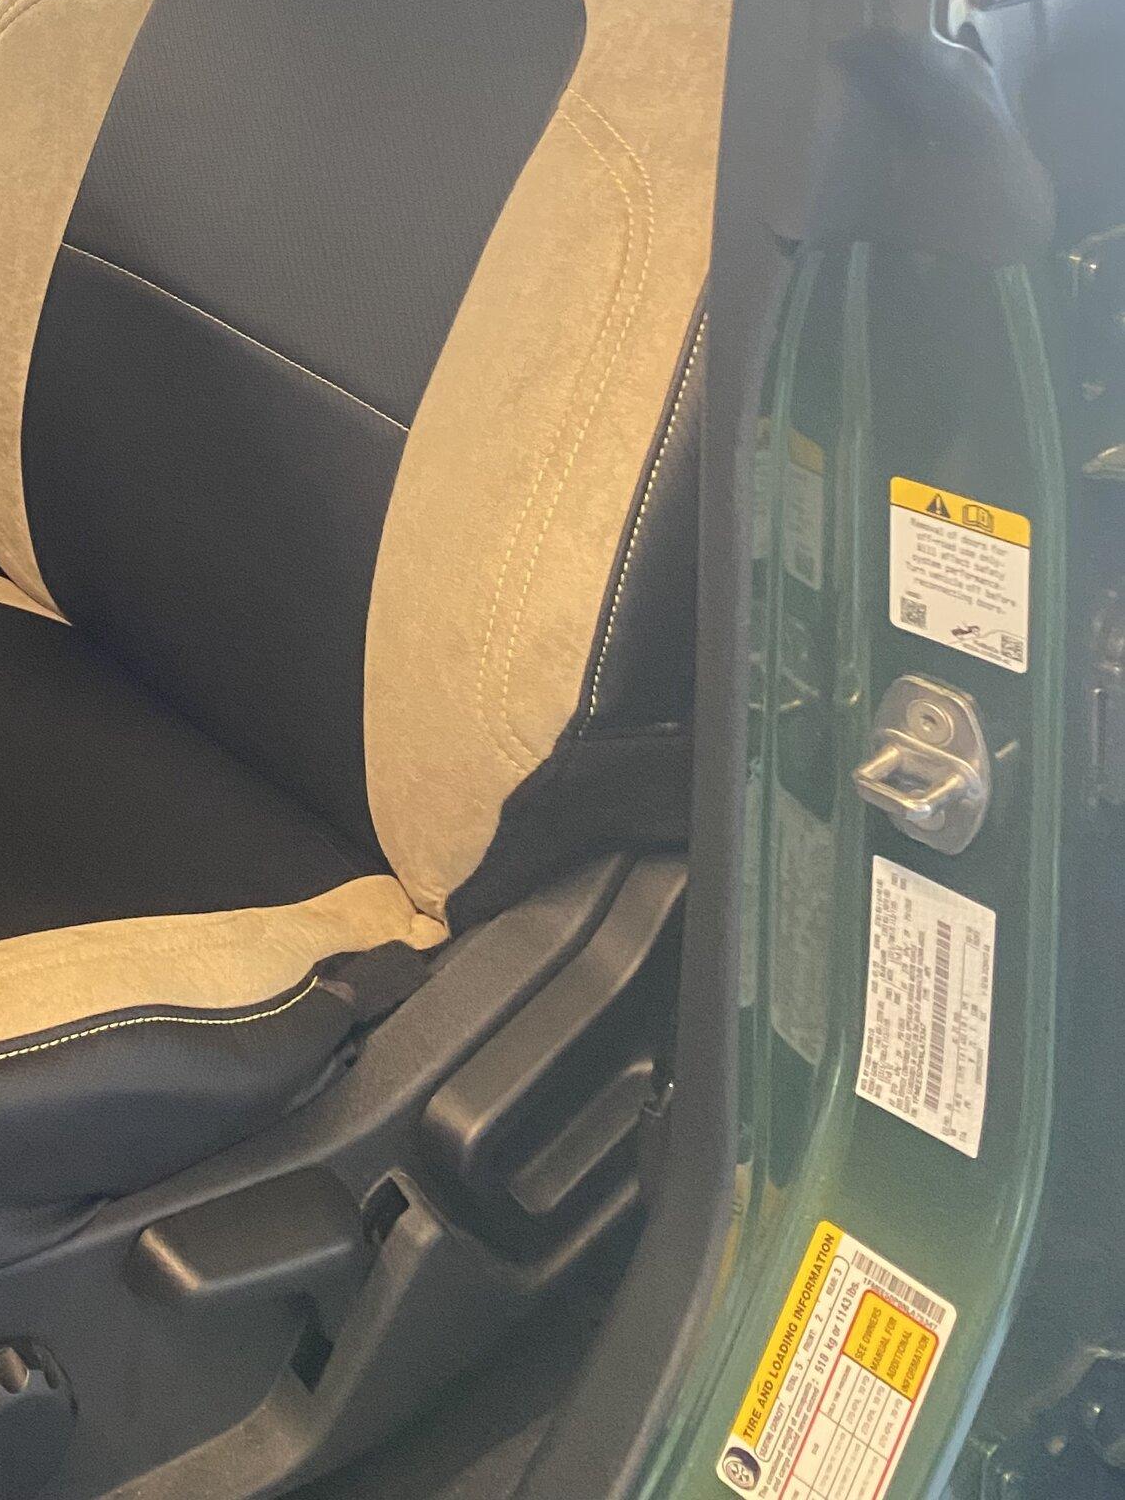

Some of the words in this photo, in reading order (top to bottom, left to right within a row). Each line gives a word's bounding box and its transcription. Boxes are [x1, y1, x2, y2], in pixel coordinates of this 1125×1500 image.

[814, 1313, 823, 1323] 2
[832, 1266, 842, 1277] 3
[834, 1295, 852, 1323] 1143
[743, 1408, 762, 1440] TIRE
[757, 1380, 774, 1408] AND
[772, 1322, 798, 1378] LOADING
[794, 1233, 835, 1321] INFORMATION
[831, 1323, 841, 1337] or
[884, 1315, 897, 1336] FOR
[823, 1334, 838, 1352] kg
[853, 1342, 867, 1362] SEE
[885, 1327, 912, 1380] ADDITIONAL
